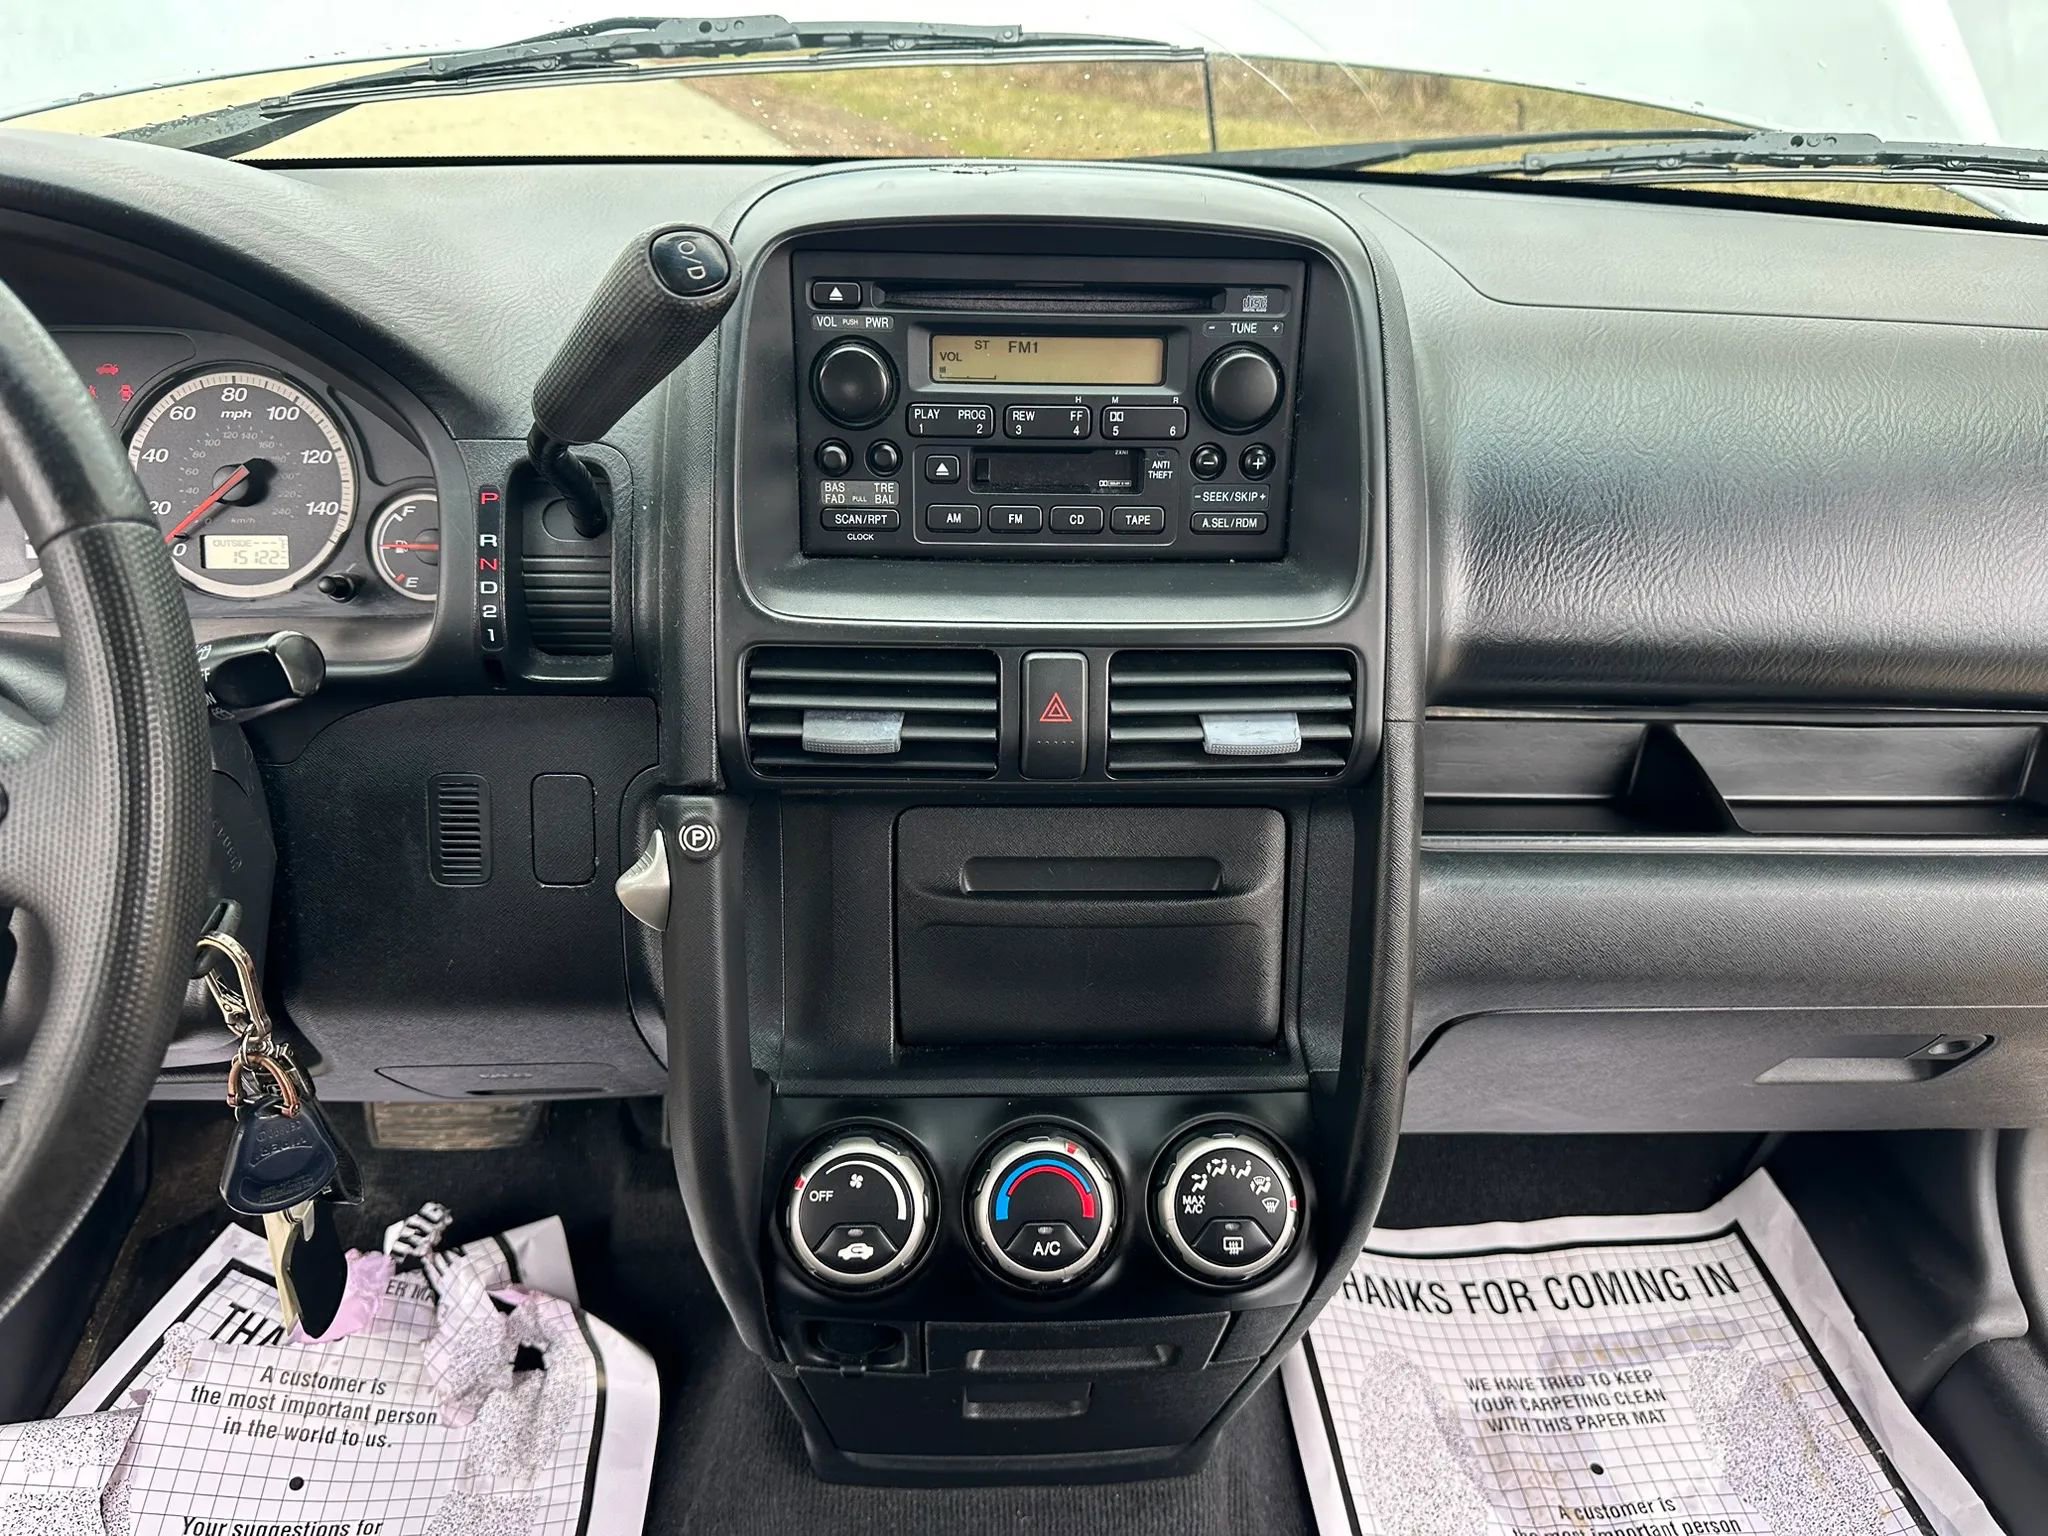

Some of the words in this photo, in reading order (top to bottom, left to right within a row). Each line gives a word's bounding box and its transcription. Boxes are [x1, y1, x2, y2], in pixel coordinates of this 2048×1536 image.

[677, 241, 706, 279] O/D
[816, 316, 837, 327] VOL
[865, 317, 889, 328] PWR
[1231, 322, 1257, 334] TUNE
[974, 340, 990, 350] ST
[1008, 341, 1038, 353] FM1
[939, 351, 963, 362] VOL
[221, 387, 248, 402] 80
[1112, 396, 1119, 404] M
[169, 406, 197, 421] 60
[221, 409, 252, 421] mph
[266, 406, 301, 421] 100
[914, 409, 941, 420] PLAY
[958, 410, 986, 420] PROG
[1012, 411, 1035, 421] REW
[1070, 411, 1084, 421] FF
[918, 424, 924, 434] 1
[976, 424, 983, 434] 2
[1015, 424, 1022, 435] 3
[1073, 426, 1080, 436] 4
[1112, 426, 1119, 436] 5
[1169, 426, 1176, 436] 6
[141, 448, 169, 463] 40
[300, 449, 333, 464] 120
[1152, 460, 1170, 469] ANTI
[1148, 471, 1173, 480] THEFT
[824, 483, 845, 492] BAS
[874, 483, 894, 493] TRE
[481, 492, 499, 505] P
[824, 494, 845, 504] FAD
[874, 494, 895, 504] BAL
[150, 500, 172, 515] 20
[305, 501, 339, 516] 140
[402, 505, 417, 517] F
[835, 514, 888, 525] SCAN/RPT
[946, 514, 962, 524] AM
[1008, 514, 1023, 524] FM
[1069, 514, 1085, 525] CD
[1125, 515, 1151, 525] TAPE
[480, 534, 497, 547] R
[847, 533, 874, 541] CLOCK
[212, 539, 253, 548] OUTSIDE
[172, 543, 187, 557] 0
[480, 558, 499, 570] N
[405, 577, 419, 588] E
[480, 581, 498, 594] D
[482, 604, 497, 618] 2
[487, 628, 495, 642] 1
[809, 1190, 834, 1202] OFF
[1182, 1195, 1206, 1205] MAX
[1184, 1204, 1203, 1214] A/C
[1032, 1240, 1061, 1256] A/C
[1343, 1271, 1453, 1315] HANKS
[1461, 1280, 1537, 1315] FOR
[1543, 1267, 1691, 1311] COMING
[1693, 1262, 1740, 1298] IN
[260, 1366, 273, 1383] A
[279, 1370, 367, 1395] customer
[370, 1378, 387, 1396] is
[1464, 1377, 1490, 1392] WE
[1494, 1375, 1536, 1391] HAVE
[1537, 1374, 1586, 1391] TRIED
[1588, 1372, 1611, 1387] TO
[1613, 1369, 1653, 1385] KEEP
[190, 1385, 221, 1405] the
[227, 1392, 277, 1411] most
[280, 1395, 371, 1421] important
[375, 1409, 438, 1426] person
[1469, 1395, 1518, 1414] YOUR
[1520, 1393, 1611, 1412] CARPETING
[1614, 1388, 1667, 1405] CLEAN
[1486, 1416, 1531, 1433] WITH
[1534, 1416, 1573, 1433] THIS
[1574, 1413, 1630, 1430] PAPER
[1633, 1409, 1668, 1425] MAT
[223, 1416, 242, 1435] in
[248, 1419, 278, 1439] the
[284, 1425, 337, 1445] world
[341, 1429, 359, 1446] to
[365, 1433, 393, 1448] us.
[1558, 1505, 1571, 1520] A
[1574, 1500, 1654, 1520] customer
[1659, 1497, 1676, 1513] is
[183, 1516, 228, 1536] Your
[231, 1520, 351, 1536] suggestions
[356, 1519, 385, 1536] for
[1590, 1521, 1680, 1536] important
[1682, 1519, 1742, 1536] person
